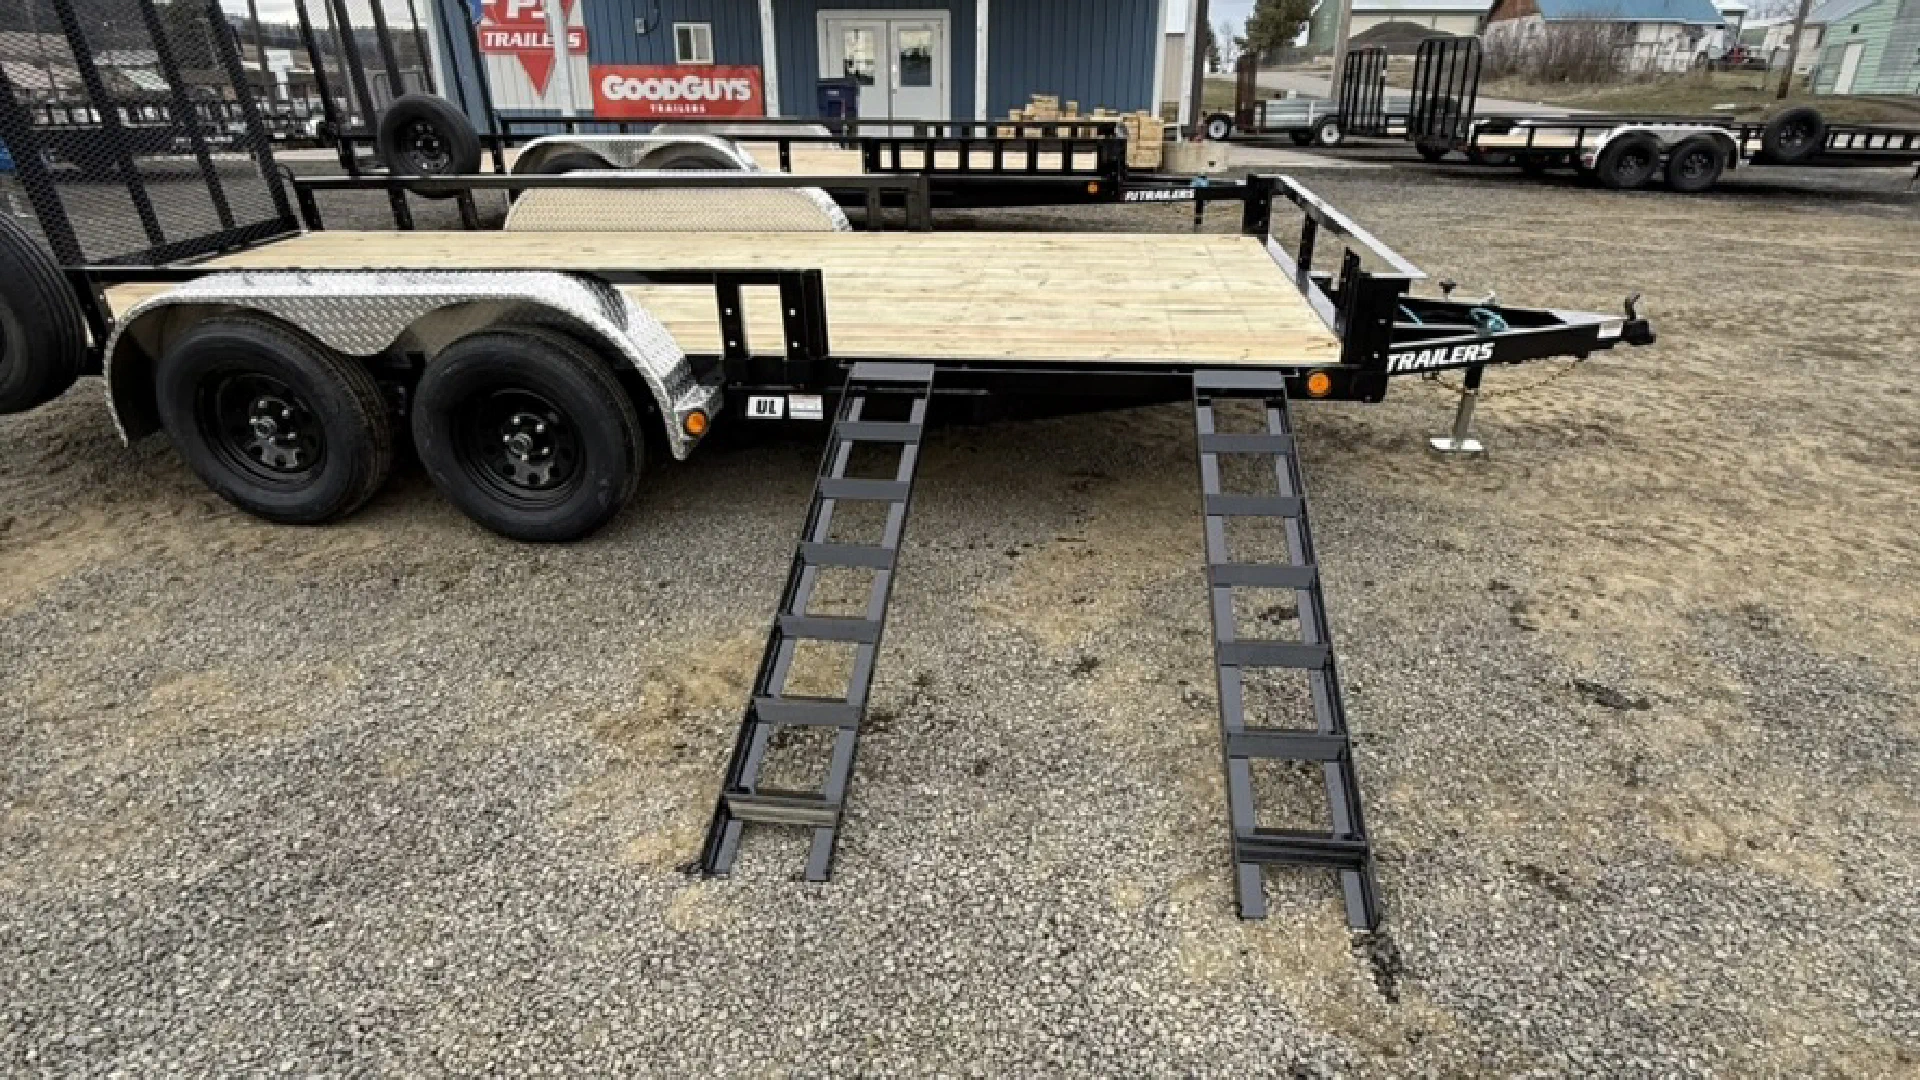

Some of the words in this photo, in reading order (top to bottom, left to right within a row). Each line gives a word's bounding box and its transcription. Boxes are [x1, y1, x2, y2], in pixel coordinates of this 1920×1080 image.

[483, 32, 582, 48] TRAILES
[601, 75, 751, 101] GOODGUYS
[650, 103, 706, 114] TRAILERS
[1387, 343, 1496, 373] TRAILERS
[756, 398, 777, 415] UL
